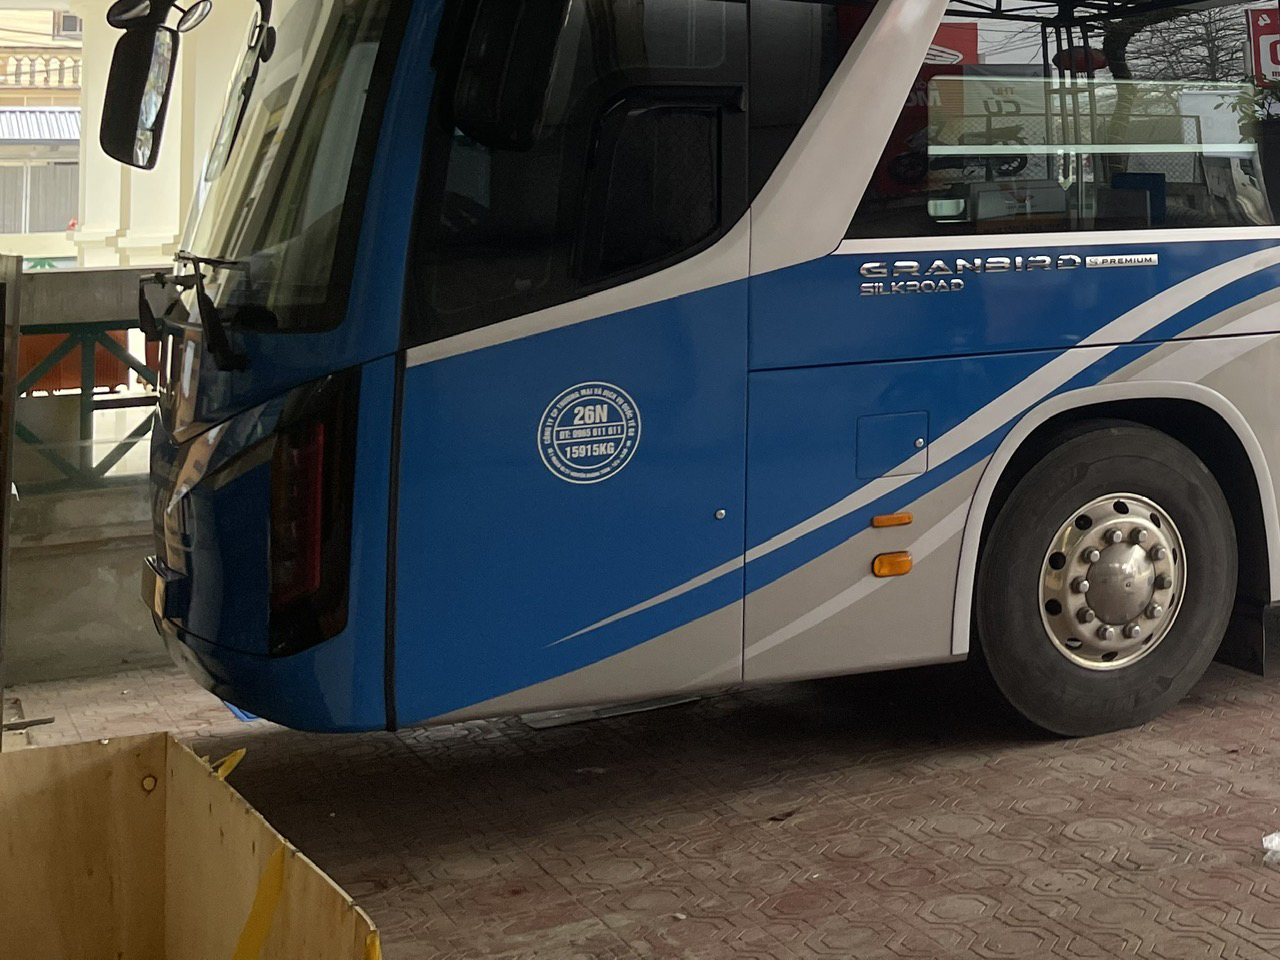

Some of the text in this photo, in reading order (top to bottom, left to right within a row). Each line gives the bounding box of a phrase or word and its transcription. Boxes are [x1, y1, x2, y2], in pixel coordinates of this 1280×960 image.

[859, 254, 1082, 278] GRANBIRD
[1101, 257, 1153, 265] PREMIUM
[859, 278, 965, 296] SILKROAD
[573, 404, 609, 426] 26N
[565, 442, 615, 460] 15915KG
